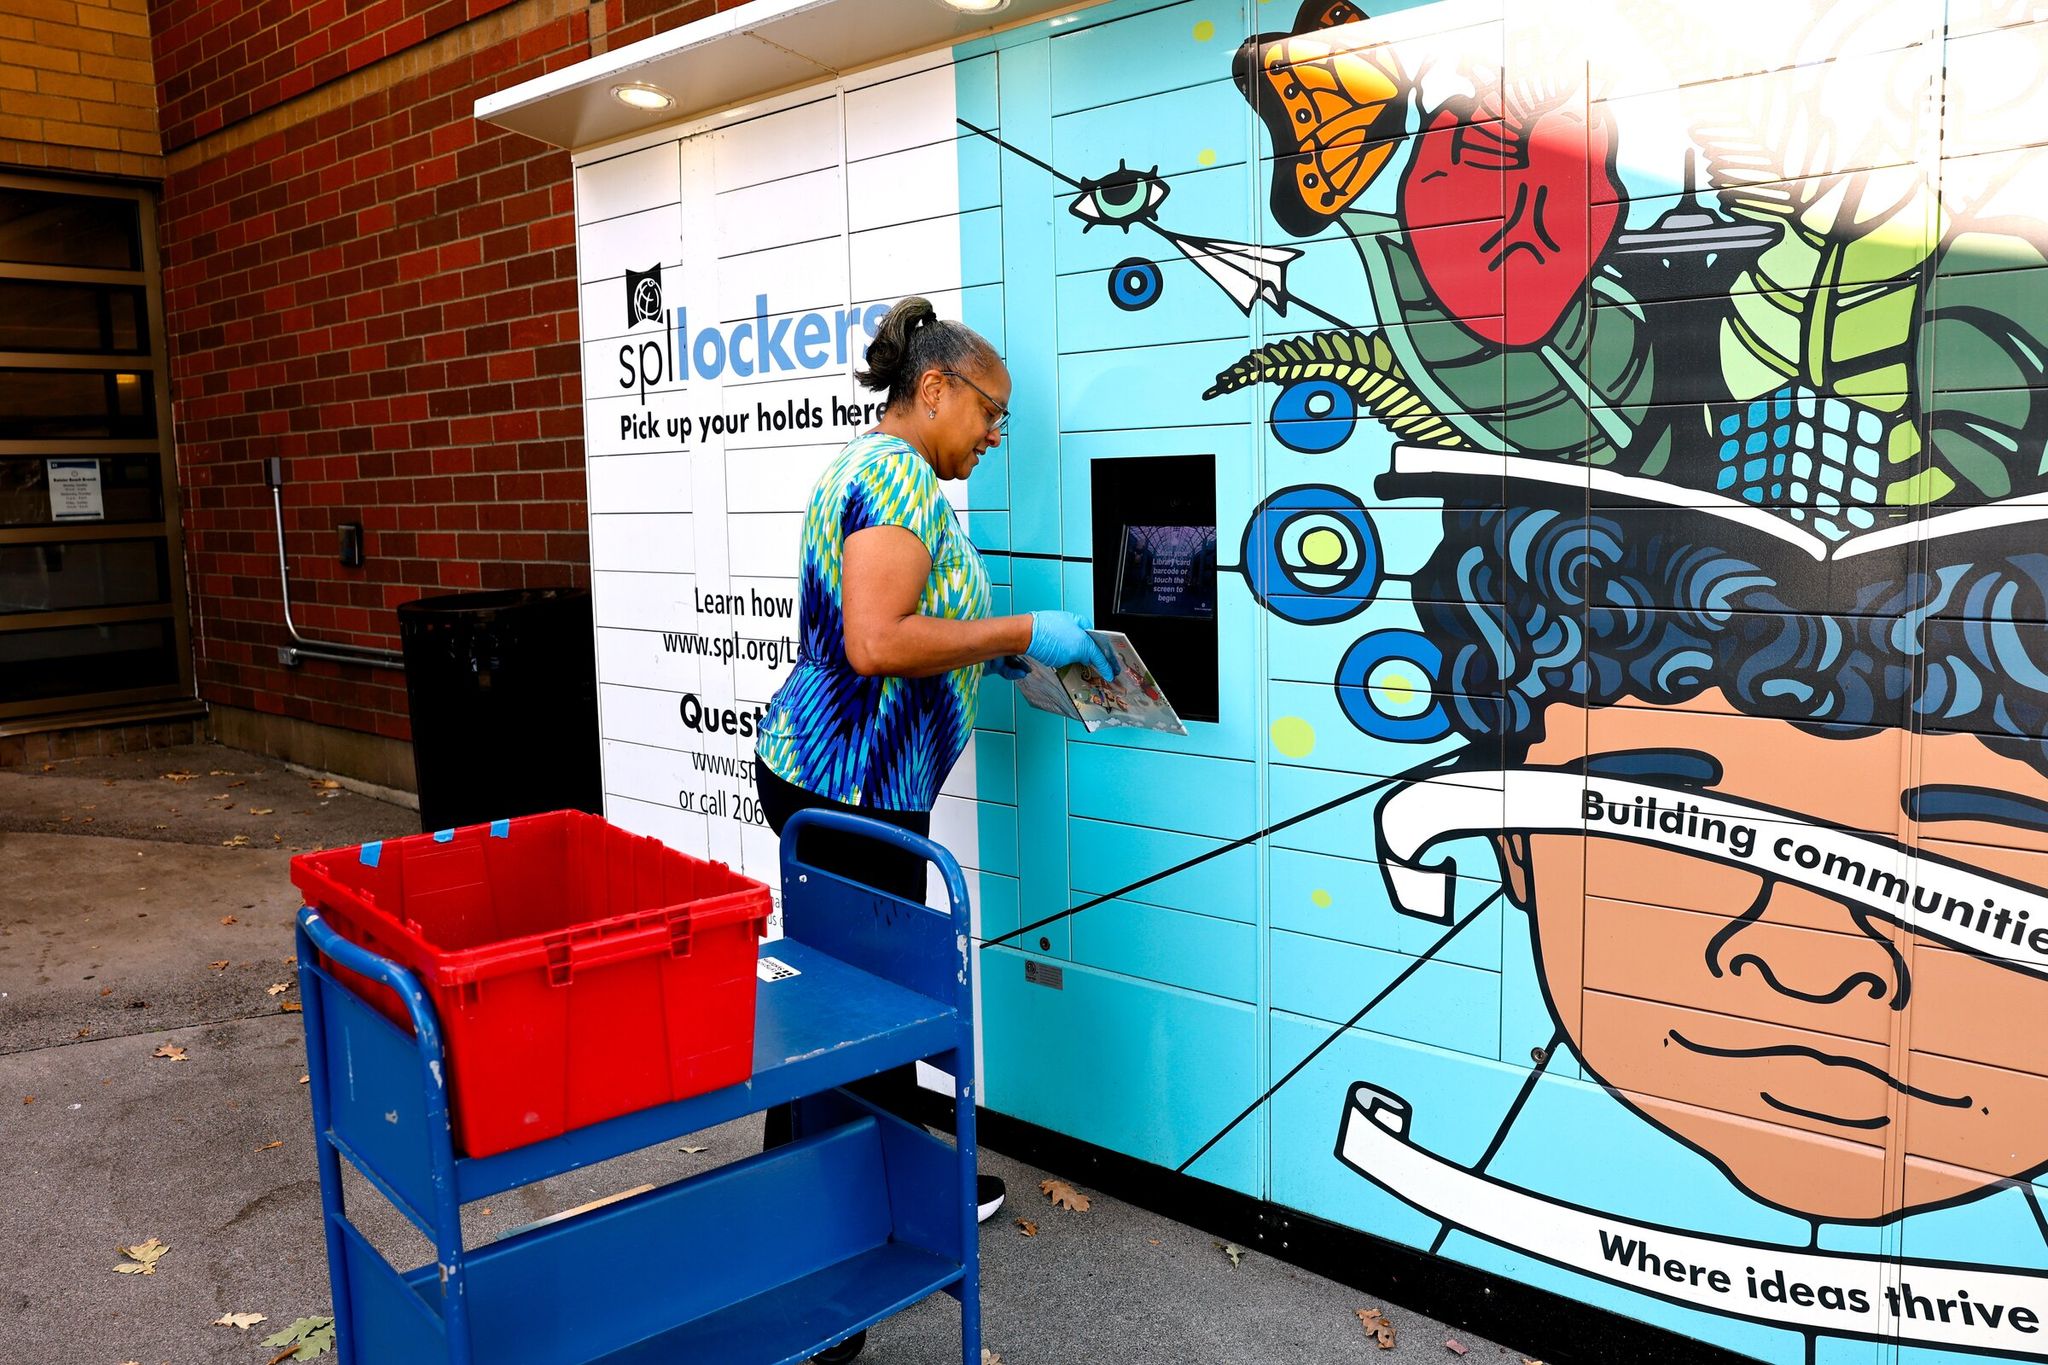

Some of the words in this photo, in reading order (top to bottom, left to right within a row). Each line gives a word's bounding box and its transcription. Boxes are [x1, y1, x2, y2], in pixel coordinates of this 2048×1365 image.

[620, 411, 661, 441] Pick
[667, 416, 692, 444] up
[699, 413, 750, 443] your
[757, 398, 823, 432] holds
[832, 395, 888, 427] here
[1152, 558, 1175, 567] Library
[1153, 567, 1179, 575] barcode
[1153, 576, 1173, 584] touch
[1173, 576, 1185, 584] the
[694, 586, 745, 616] Learn
[751, 587, 794, 619] how
[1157, 594, 1176, 603] begin
[662, 630, 801, 671] www.spl.org/L
[679, 692, 770, 739] Quest
[679, 790, 695, 810] or
[700, 789, 727, 818] call
[732, 794, 765, 825] 206
[1580, 789, 1757, 859] Building
[1598, 1229, 1732, 1293] Where
[1746, 1266, 1871, 1314] ideas
[1884, 1282, 2040, 1335] thrive
